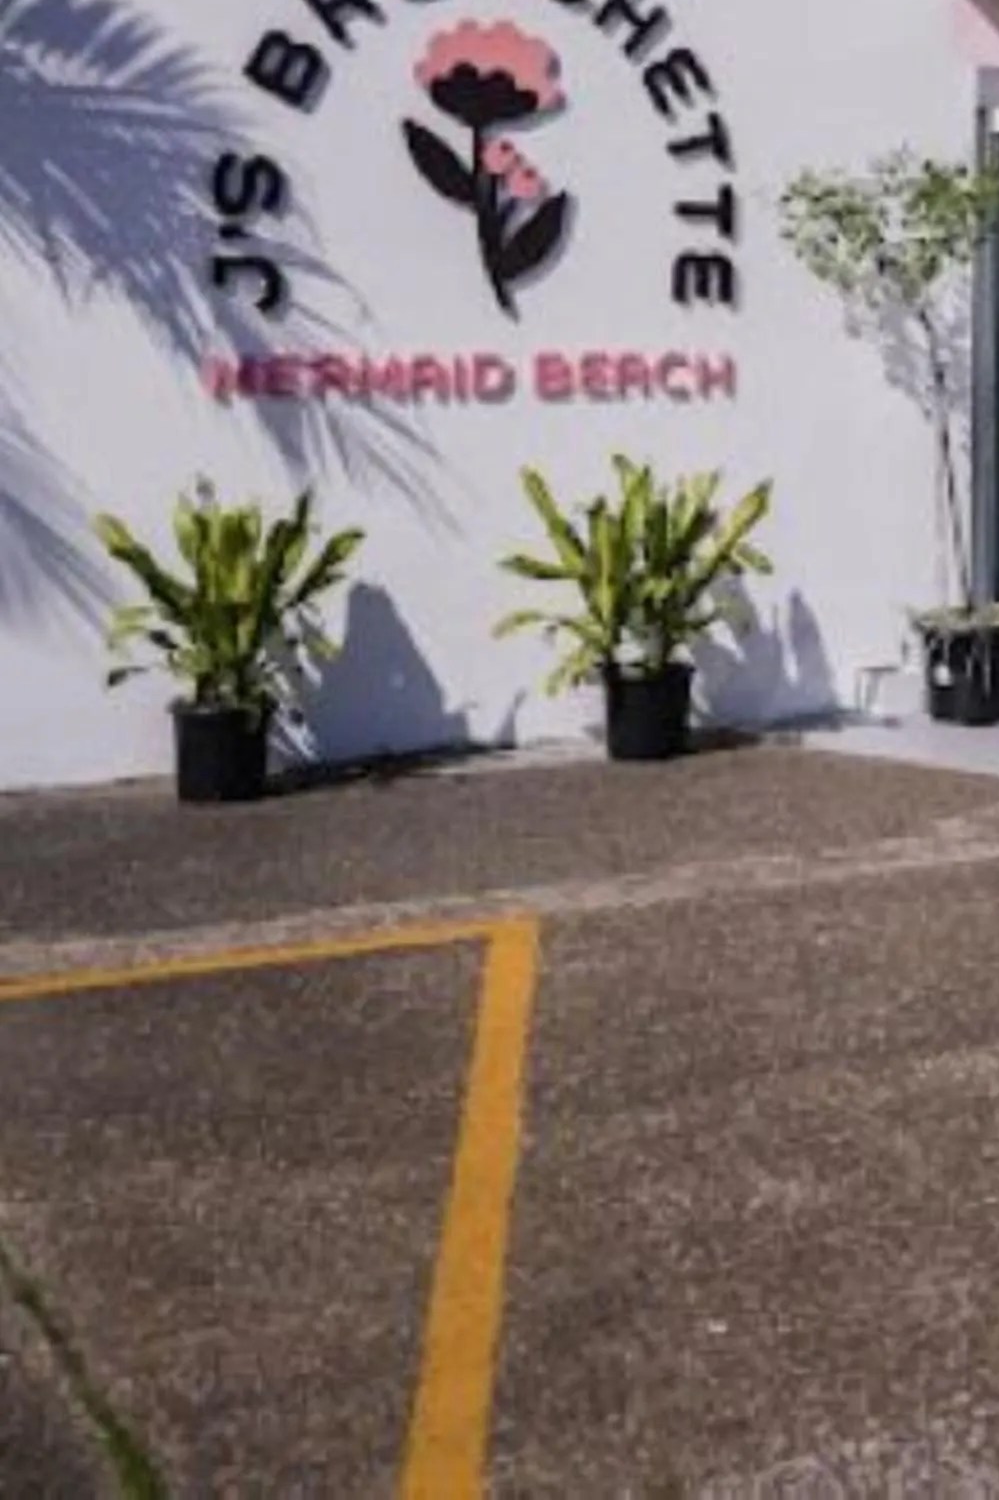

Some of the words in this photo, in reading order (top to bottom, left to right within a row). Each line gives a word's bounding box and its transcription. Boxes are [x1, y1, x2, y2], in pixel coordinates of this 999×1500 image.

[210, 154, 284, 316] J'S
[207, 351, 515, 404] MERMAID
[533, 349, 737, 403] BEACH
